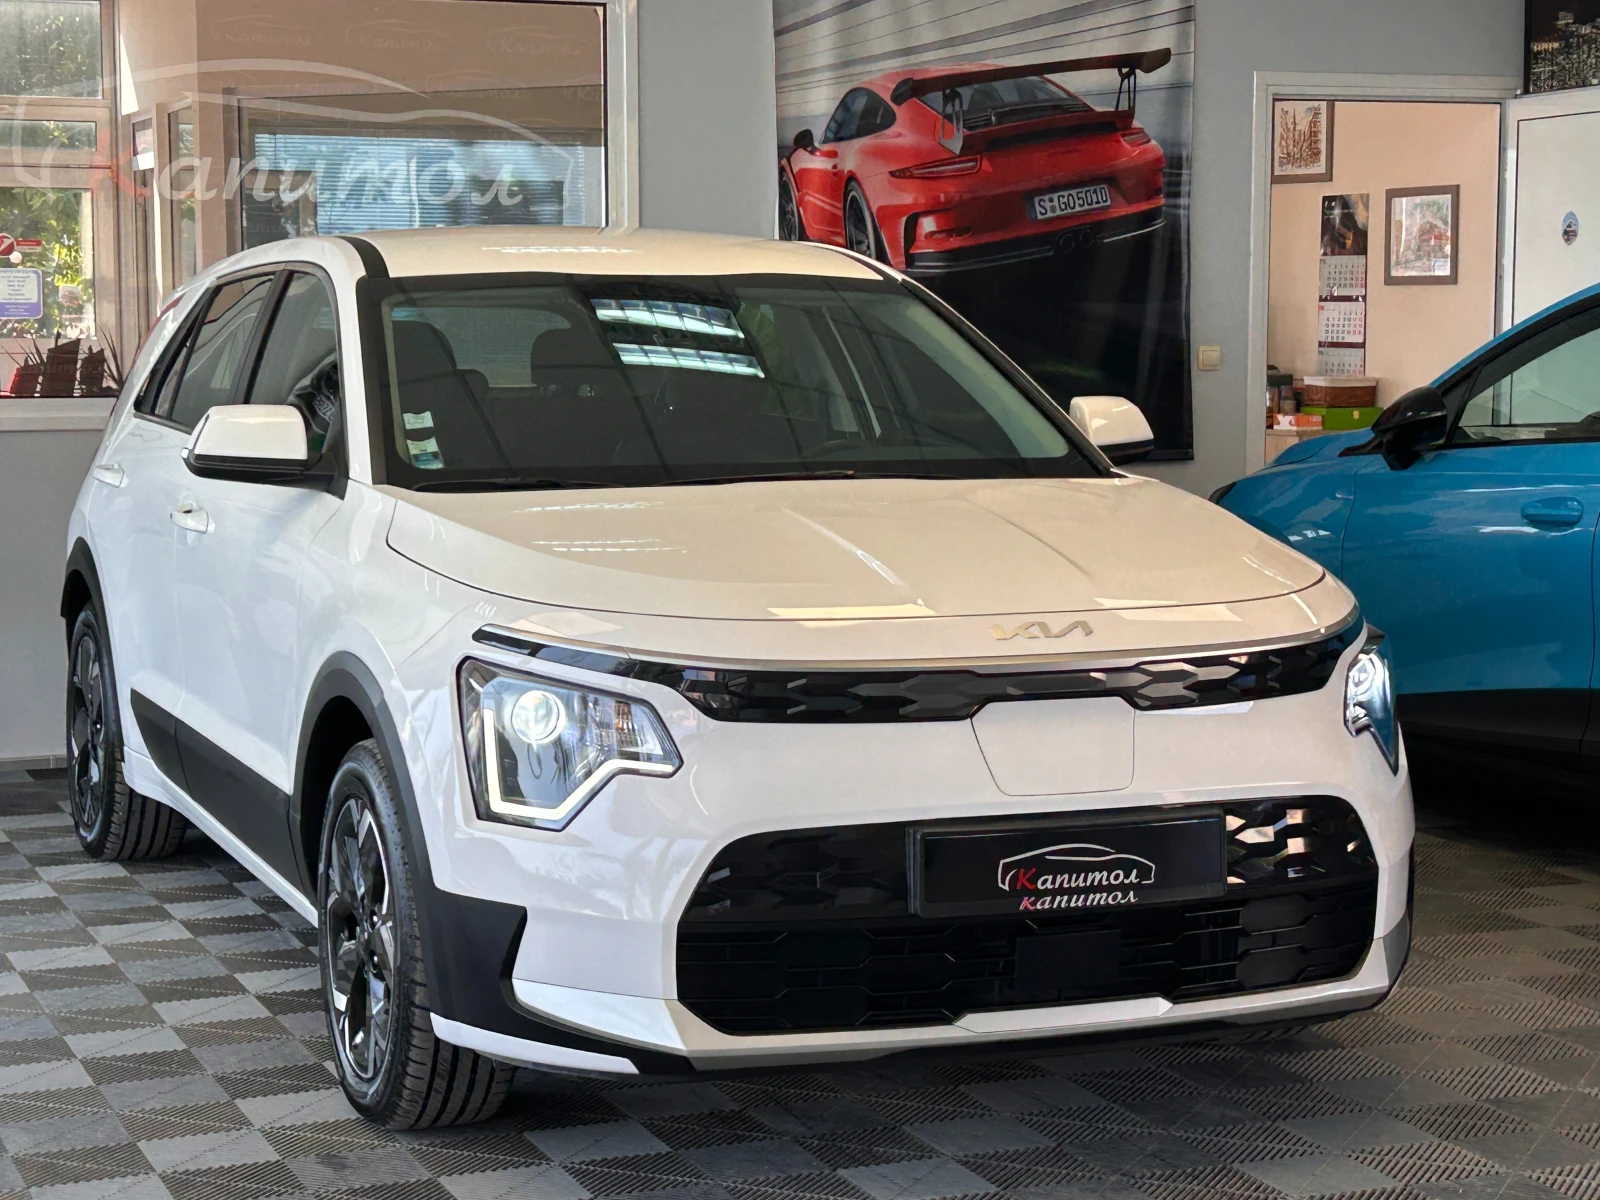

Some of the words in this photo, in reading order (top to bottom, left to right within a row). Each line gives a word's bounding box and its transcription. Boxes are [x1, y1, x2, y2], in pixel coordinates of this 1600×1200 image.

[89, 128, 524, 207] Капитол
[989, 620, 1094, 640] KIA
[1016, 867, 1140, 890] Капитол
